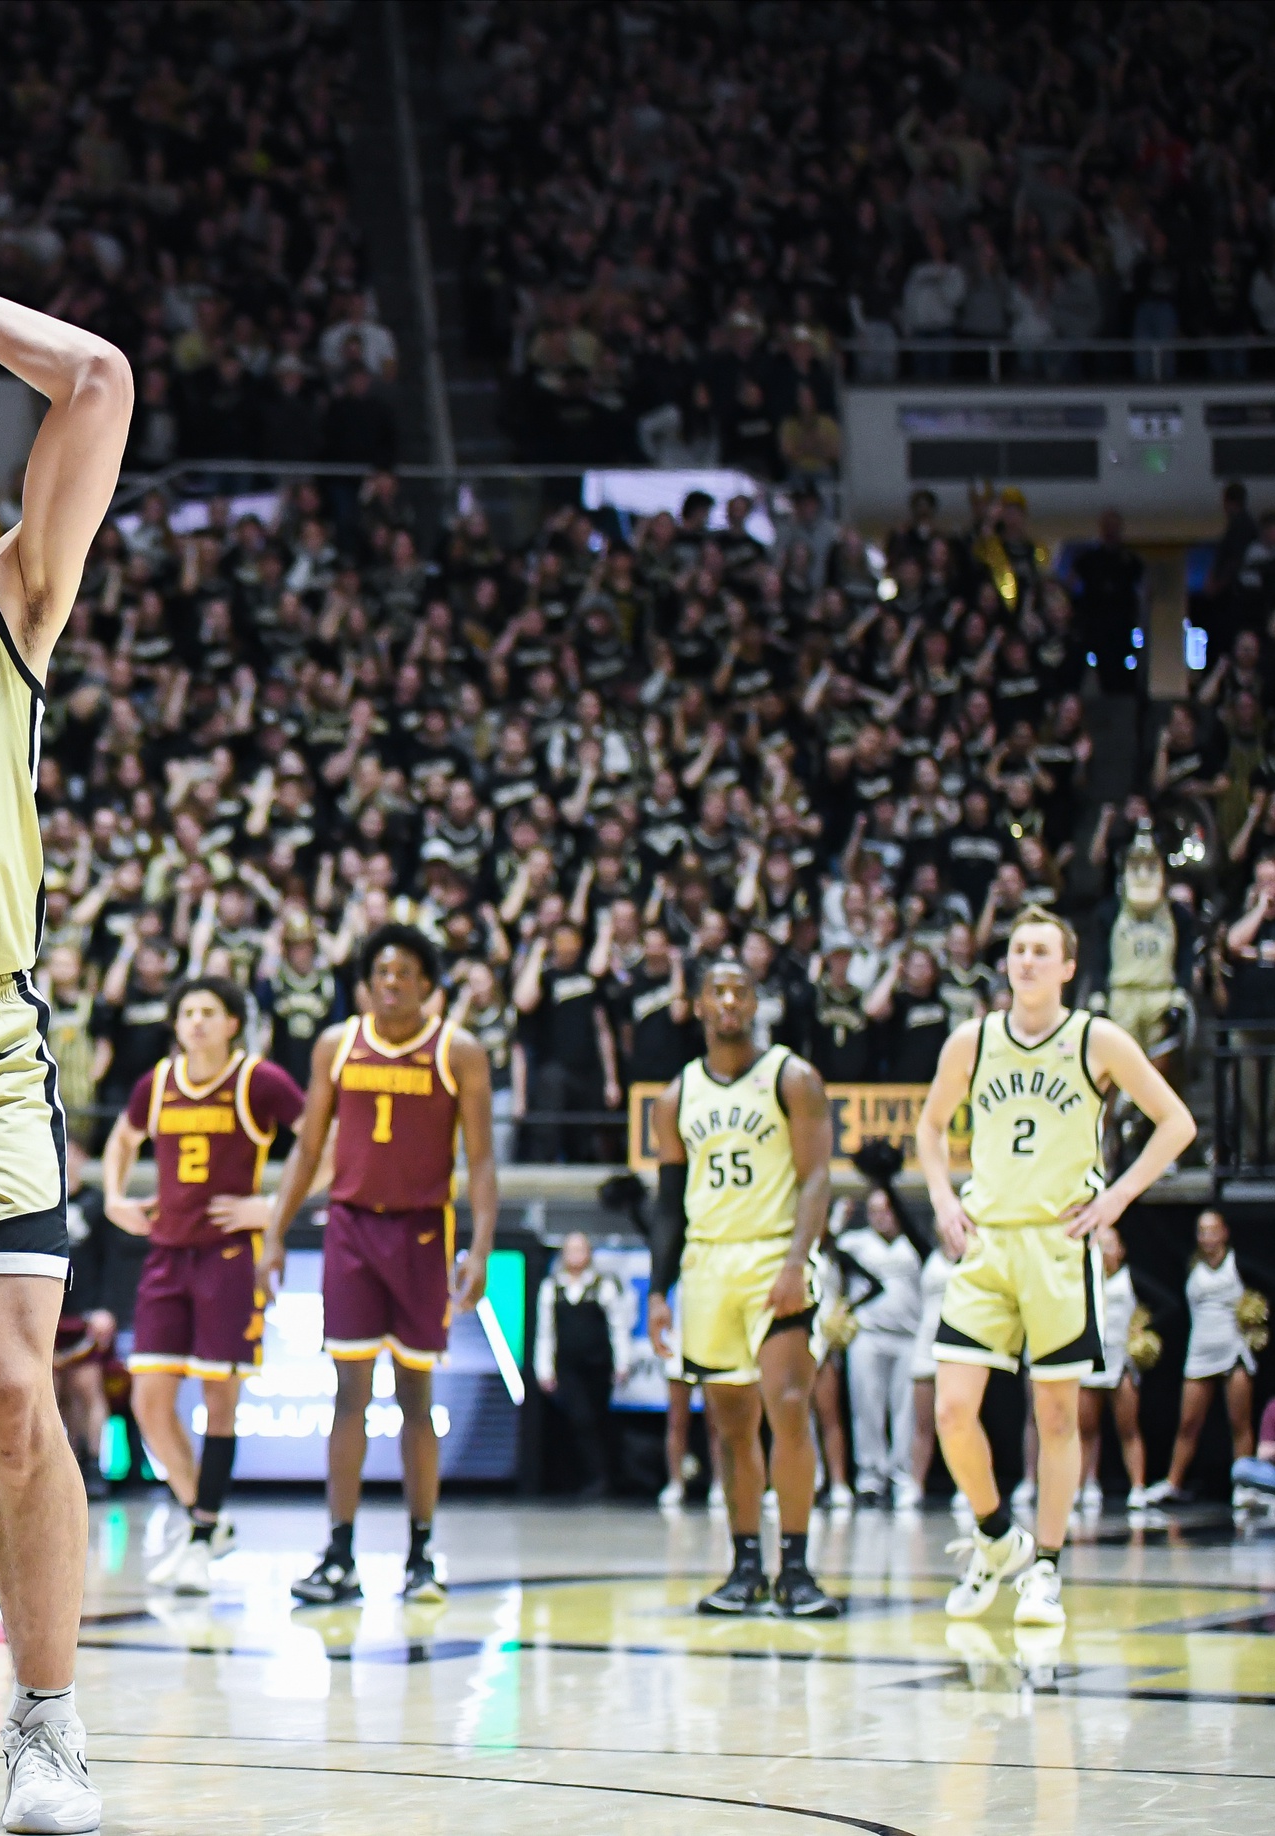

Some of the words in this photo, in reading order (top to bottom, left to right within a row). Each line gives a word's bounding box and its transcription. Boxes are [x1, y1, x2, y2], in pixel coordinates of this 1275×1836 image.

[978, 1070, 1083, 1116] PURDUE
[371, 1092, 393, 1143] 1
[685, 1105, 778, 1154] PURDUE
[1011, 1118, 1036, 1154] 2
[177, 1133, 210, 1184] 2
[708, 1149, 753, 1189] 55
